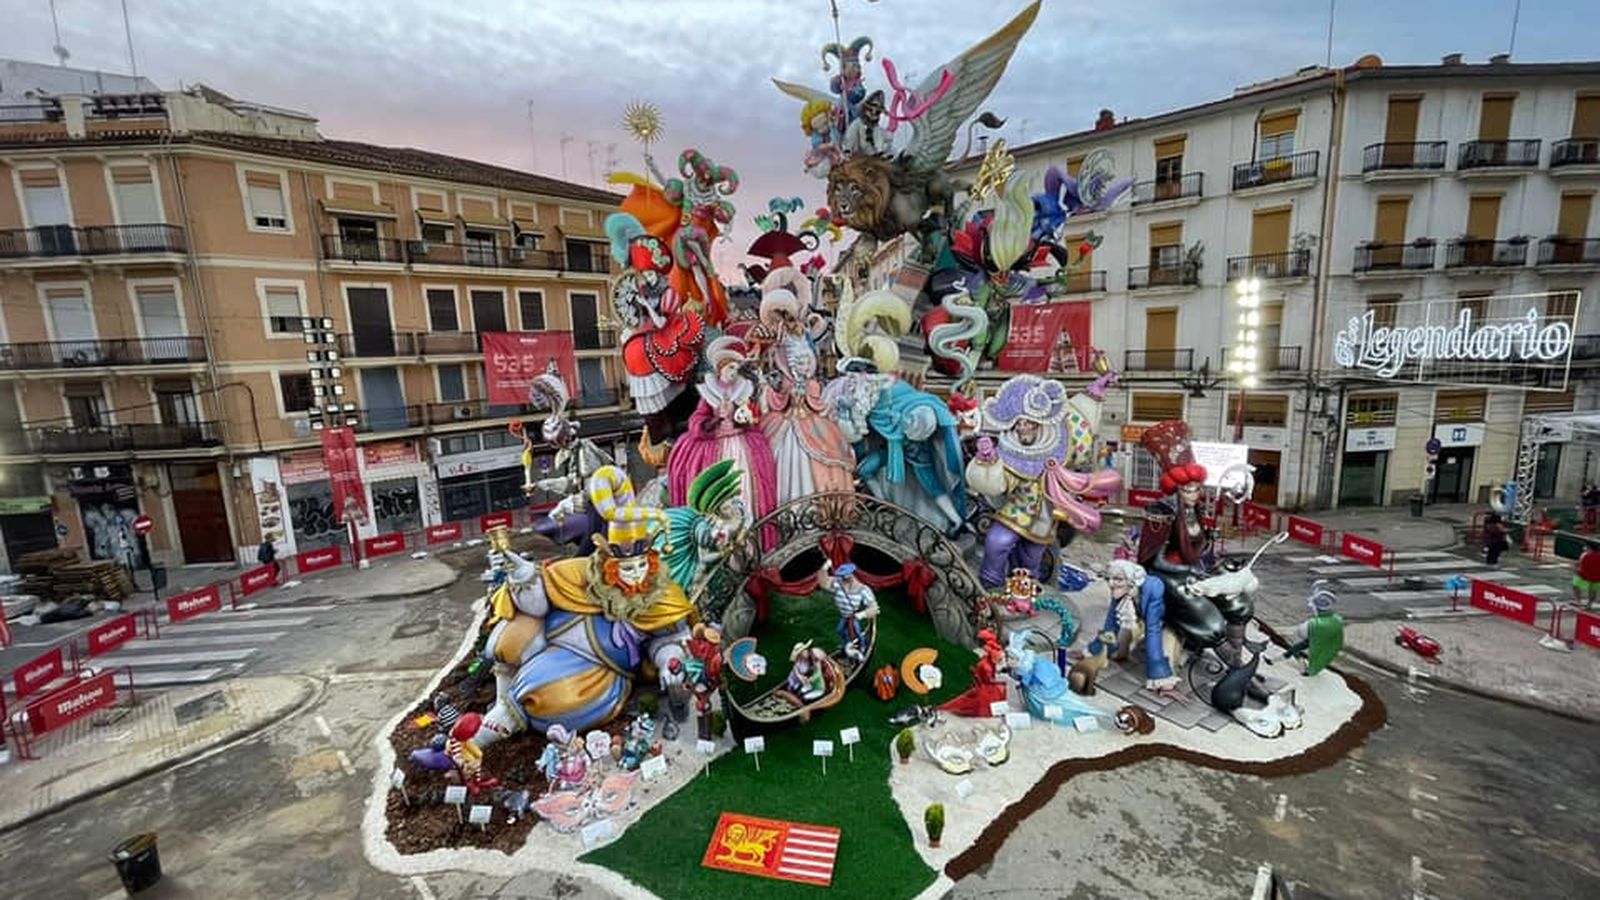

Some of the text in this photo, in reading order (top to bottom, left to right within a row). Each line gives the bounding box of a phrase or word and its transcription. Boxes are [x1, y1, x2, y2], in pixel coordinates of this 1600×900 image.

[1357, 307, 1570, 377] Legendario
[178, 594, 213, 611] Mahou
[1483, 590, 1523, 611] Mahou
[57, 686, 104, 715] Mahou
